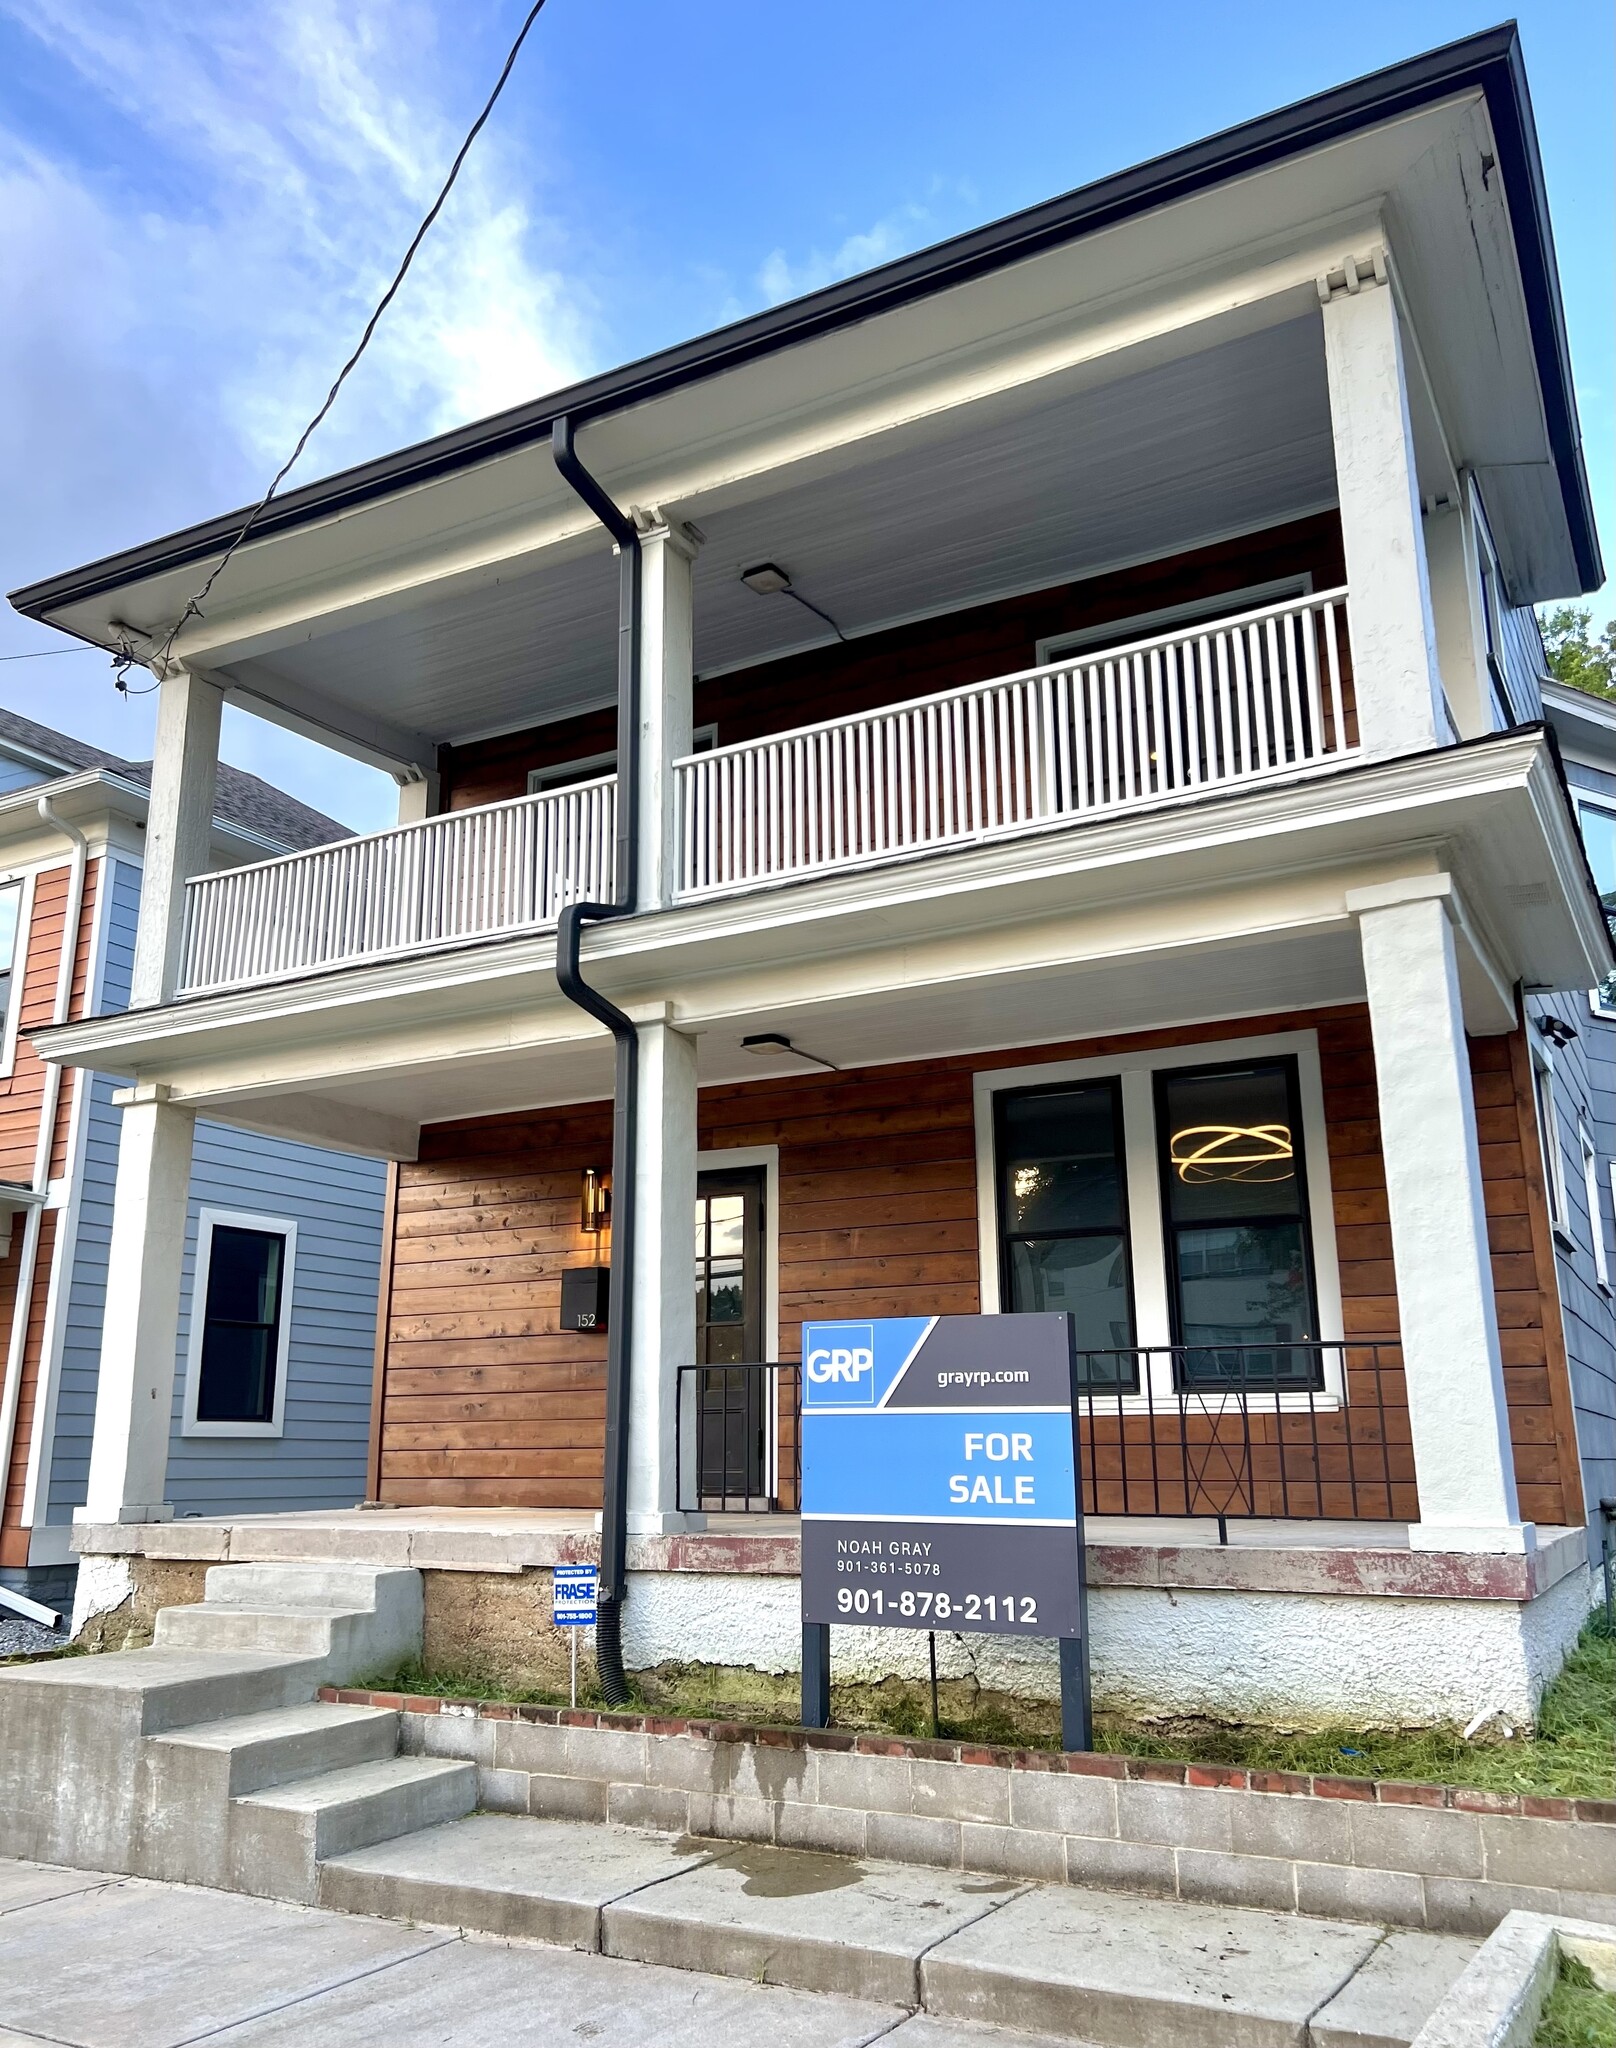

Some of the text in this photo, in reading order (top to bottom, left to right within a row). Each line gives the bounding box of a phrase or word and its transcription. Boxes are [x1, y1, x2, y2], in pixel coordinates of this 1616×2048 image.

[577, 1313, 596, 1327] 152
[807, 1348, 873, 1383] GRP
[937, 1368, 1029, 1388] grayrp.com
[964, 1432, 1034, 1461] FOR
[949, 1475, 1035, 1505] SALE
[837, 1539, 932, 1557] NOAH GRAY
[837, 1560, 941, 1576] 901-361-5078
[555, 1583, 595, 1600] FRASE
[837, 1588, 1038, 1624] 901-878-2112
